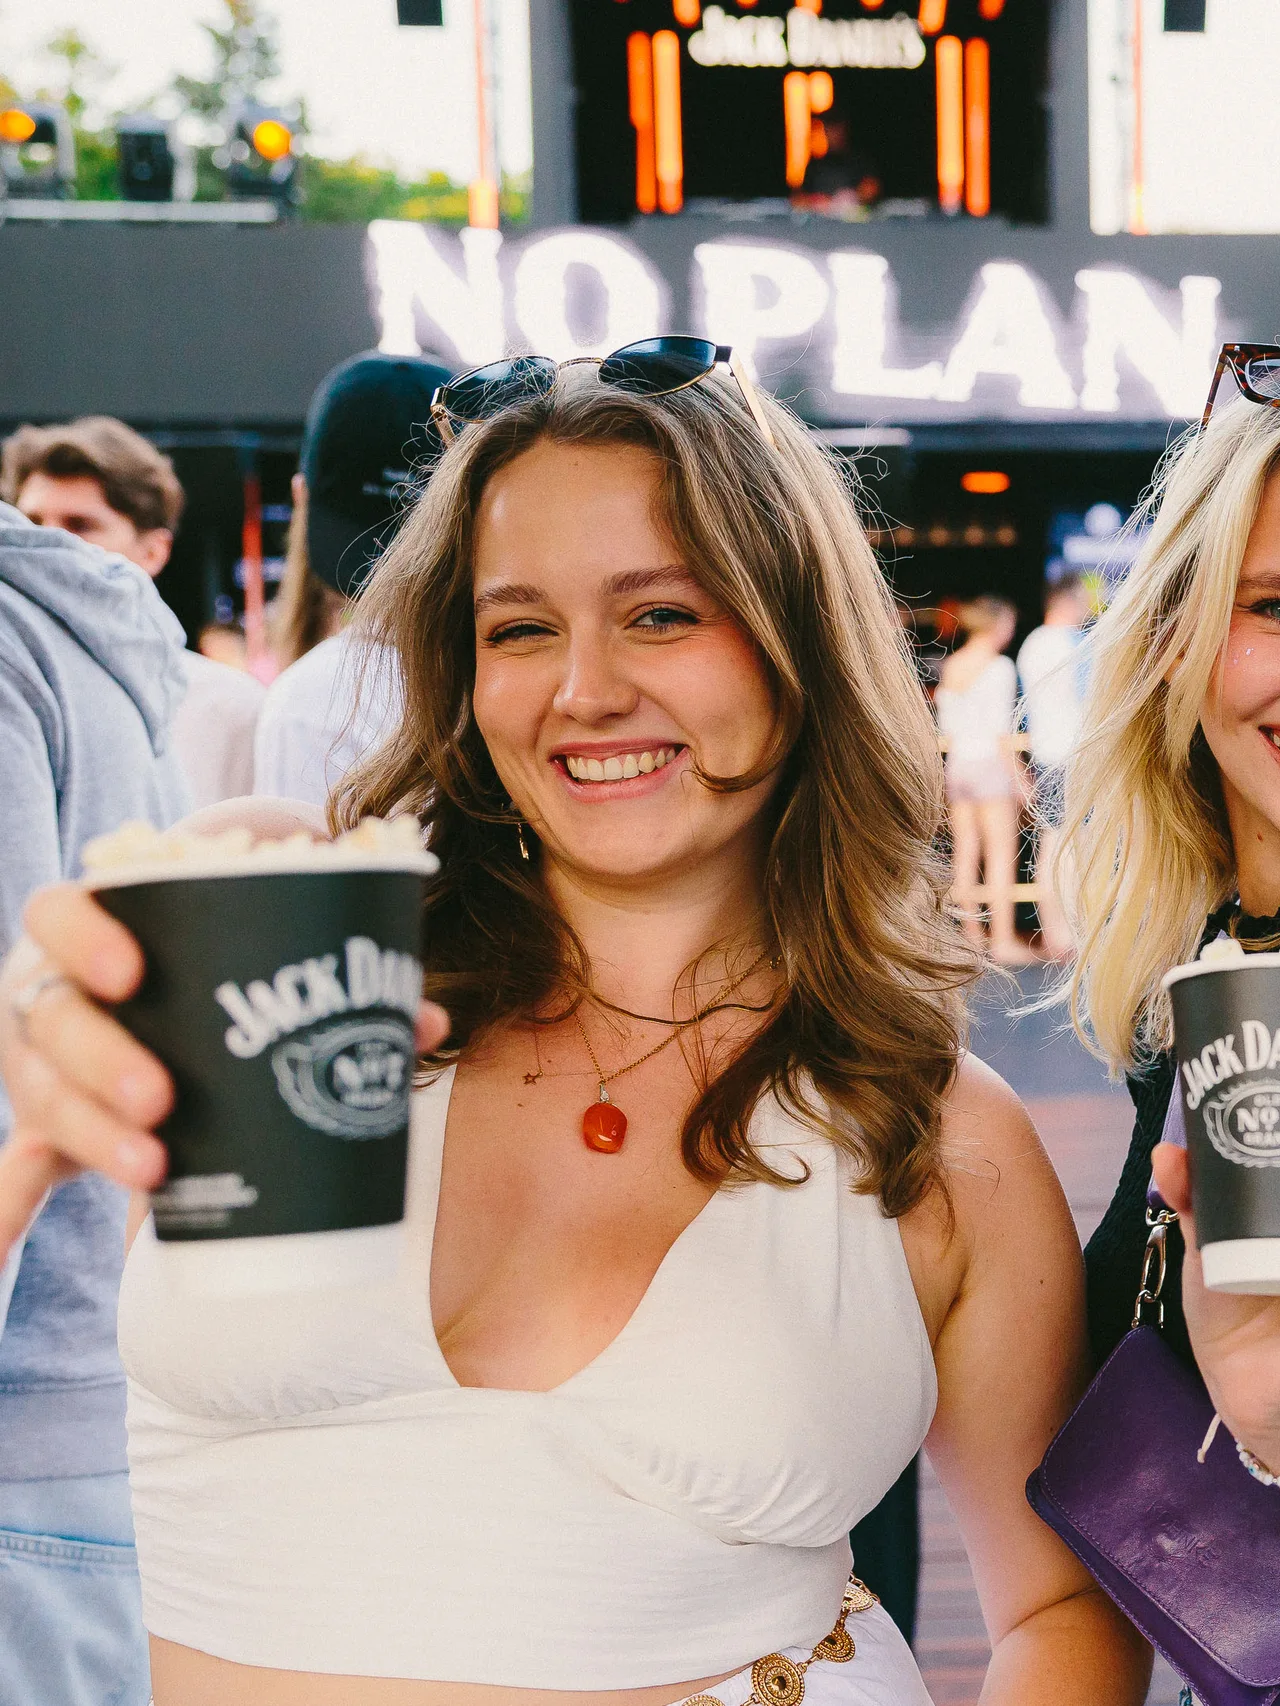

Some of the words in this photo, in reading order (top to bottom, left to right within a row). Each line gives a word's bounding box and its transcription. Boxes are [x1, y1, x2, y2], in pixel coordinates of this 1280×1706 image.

[367, 219, 661, 366] NO
[694, 241, 1222, 418] PLAN
[214, 953, 347, 1059] JACK
[1182, 1034, 1245, 1110] JACK
